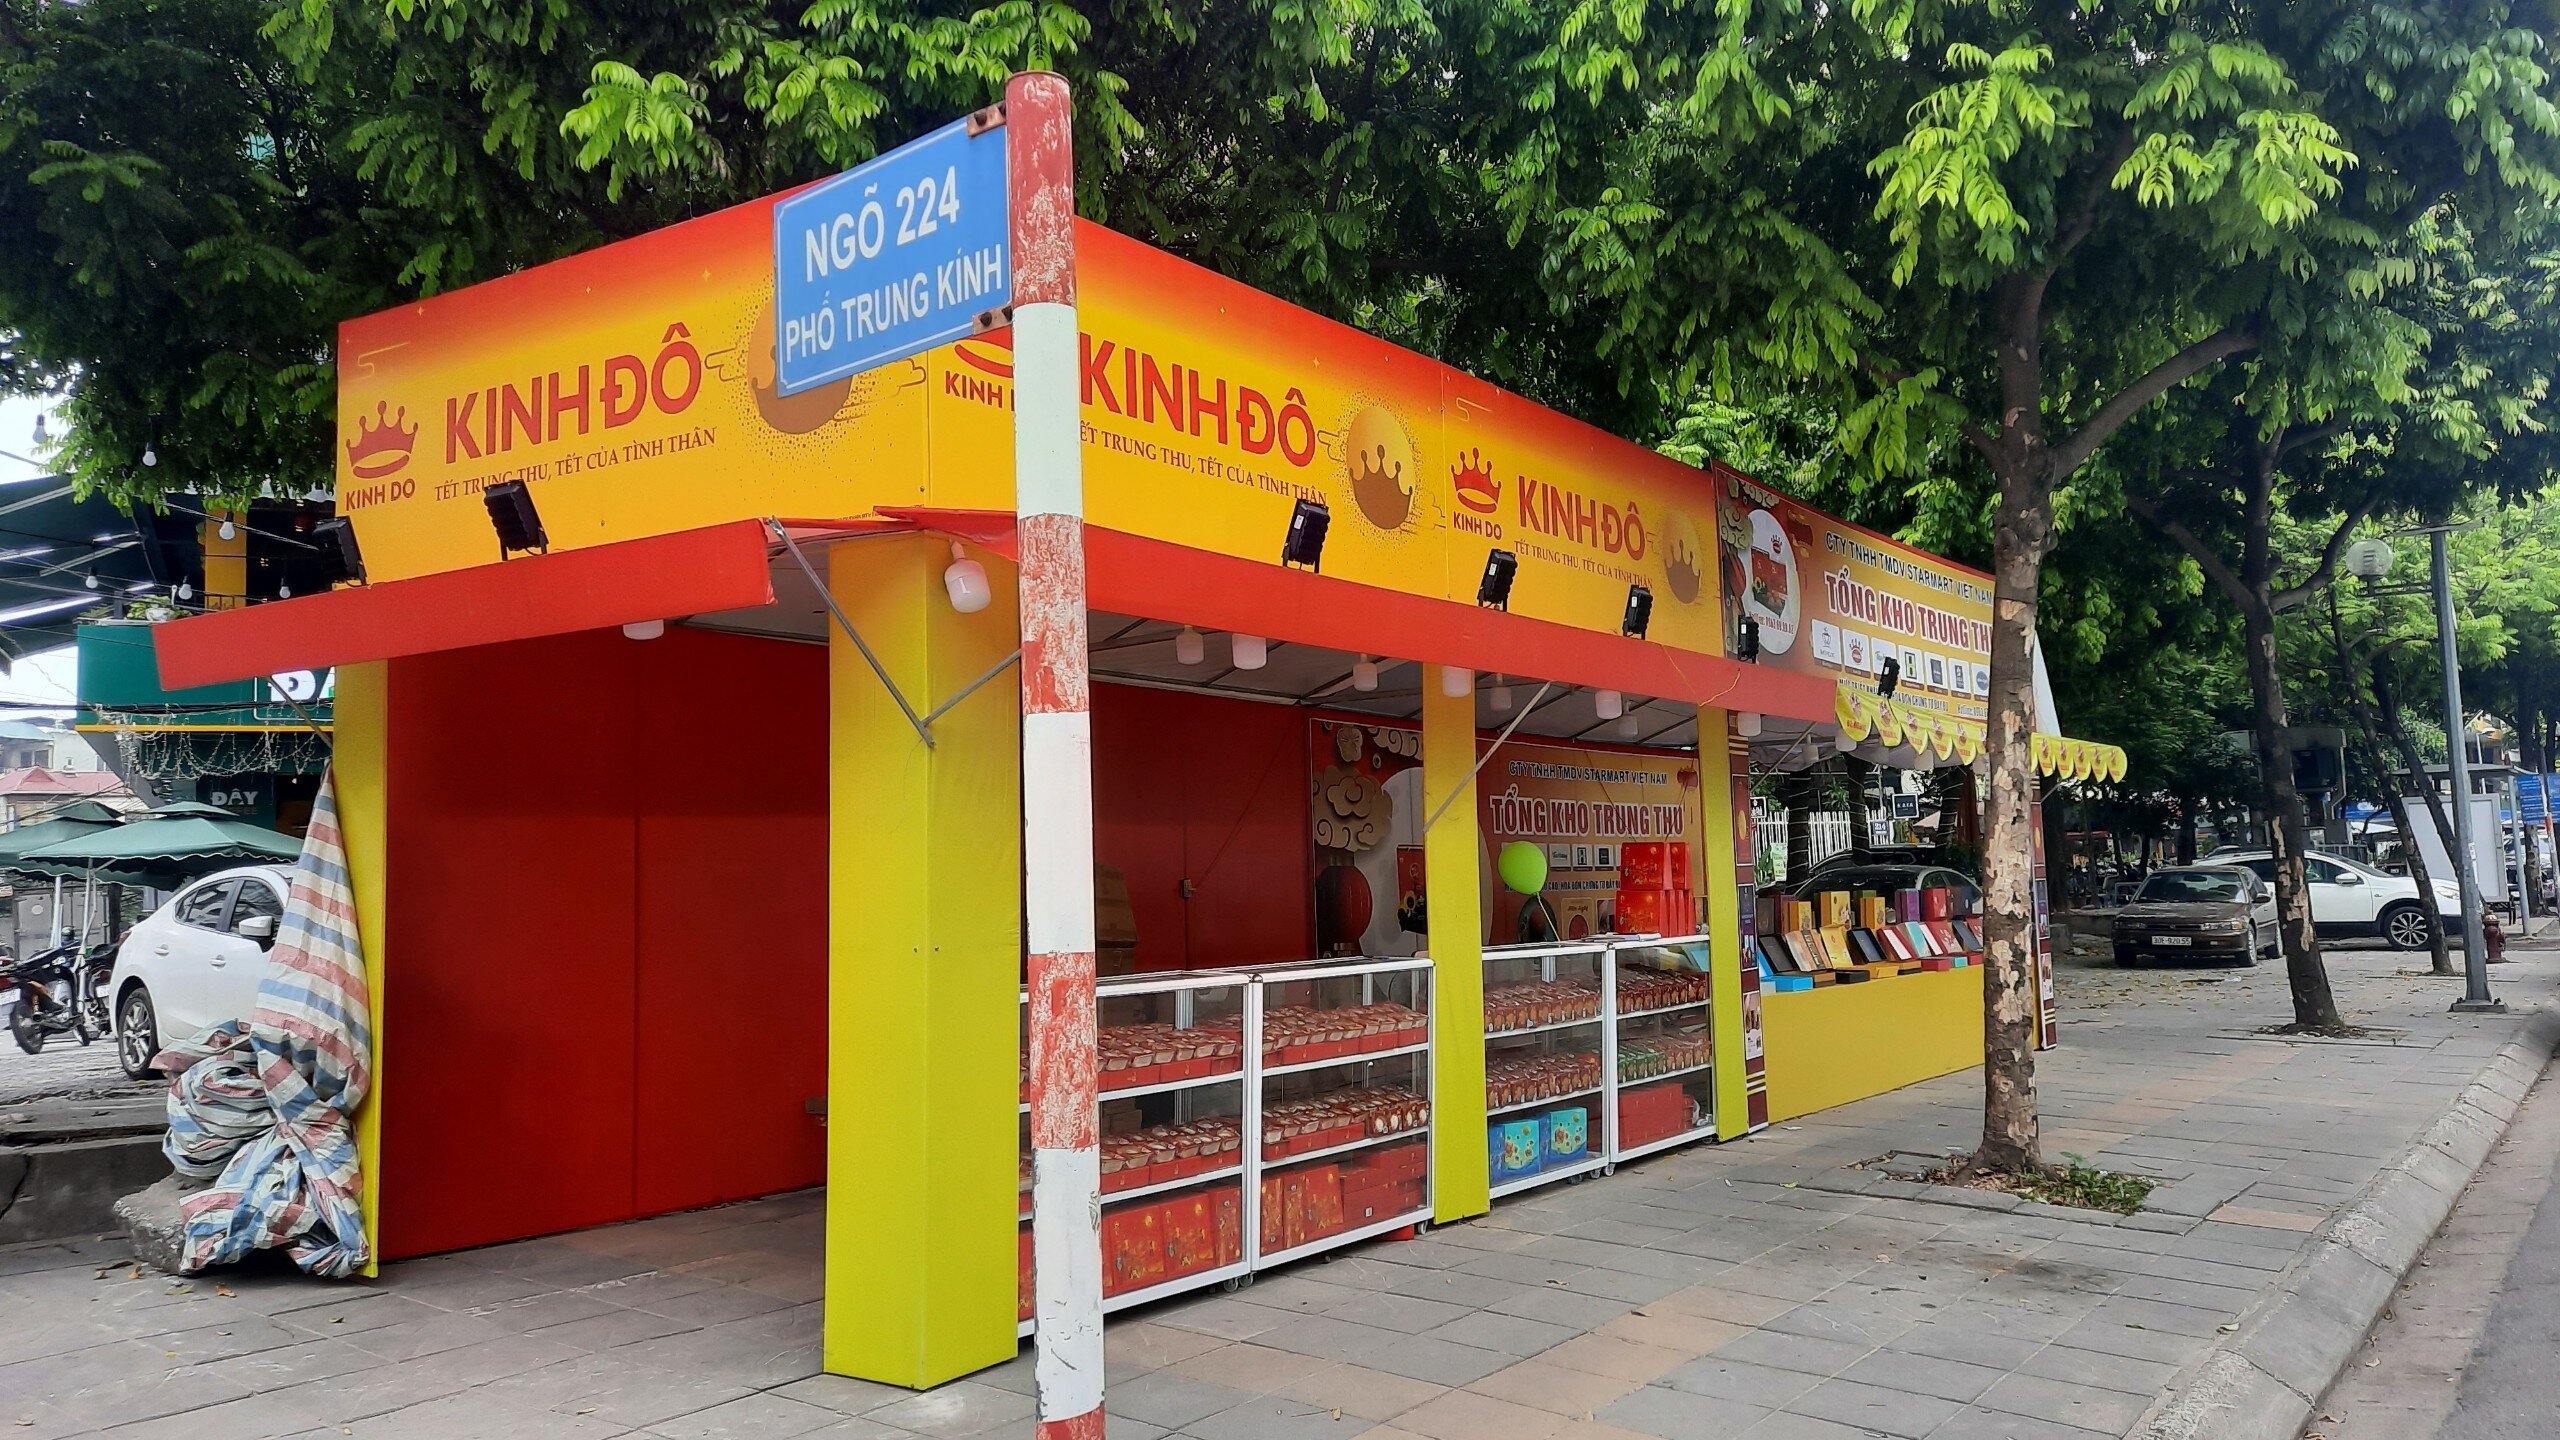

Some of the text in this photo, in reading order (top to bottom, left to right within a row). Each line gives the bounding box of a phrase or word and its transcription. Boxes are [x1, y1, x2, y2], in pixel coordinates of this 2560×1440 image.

[805, 166, 959, 283] NGÕ 224
[785, 244, 1002, 363] PHỐ TRUNG KÍNH
[446, 322, 702, 465] KINH ĐÔ
[946, 370, 1003, 409] KINH
[1079, 332, 1317, 468] KINH ĐÔ
[345, 478, 416, 511] KINH DO
[435, 479, 459, 501] TẾT
[517, 463, 551, 483] THU,
[555, 452, 583, 476] TẾT
[586, 445, 619, 471] CỦA
[624, 440, 664, 463] TÌNH
[668, 427, 718, 452] THÂN
[1080, 420, 1328, 508] ẾT TRUNG THU, TẾT CỦA TÌNH THÂN
[1453, 511, 1503, 541] KINH DO
[1518, 475, 1646, 561] KINH ĐÔ
[1514, 538, 1529, 556] TẾT
[1531, 545, 1561, 564] TRUNG
[1581, 557, 1596, 573] TẾT
[1597, 561, 1613, 579] CỦA
[1614, 565, 1633, 584] TÌNH
[1826, 531, 1848, 555] CTY
[1849, 541, 1877, 568] TNHH
[1878, 552, 1907, 577] TMDV
[1907, 564, 1954, 595] STARMART
[1974, 586, 1993, 606] NAM
[1825, 567, 1877, 624] TỔNG
[1879, 592, 1915, 635] KHO
[1916, 605, 1969, 649] TRUNG
[1492, 784, 1684, 837] TỔNG KHO TRUNG THU
[1510, 761, 1529, 776] CTY
[1530, 764, 1556, 778] TNHH
[1558, 766, 1583, 780] TMDV
[1584, 768, 1630, 782] STARMART
[1650, 773, 1668, 785] NAM
